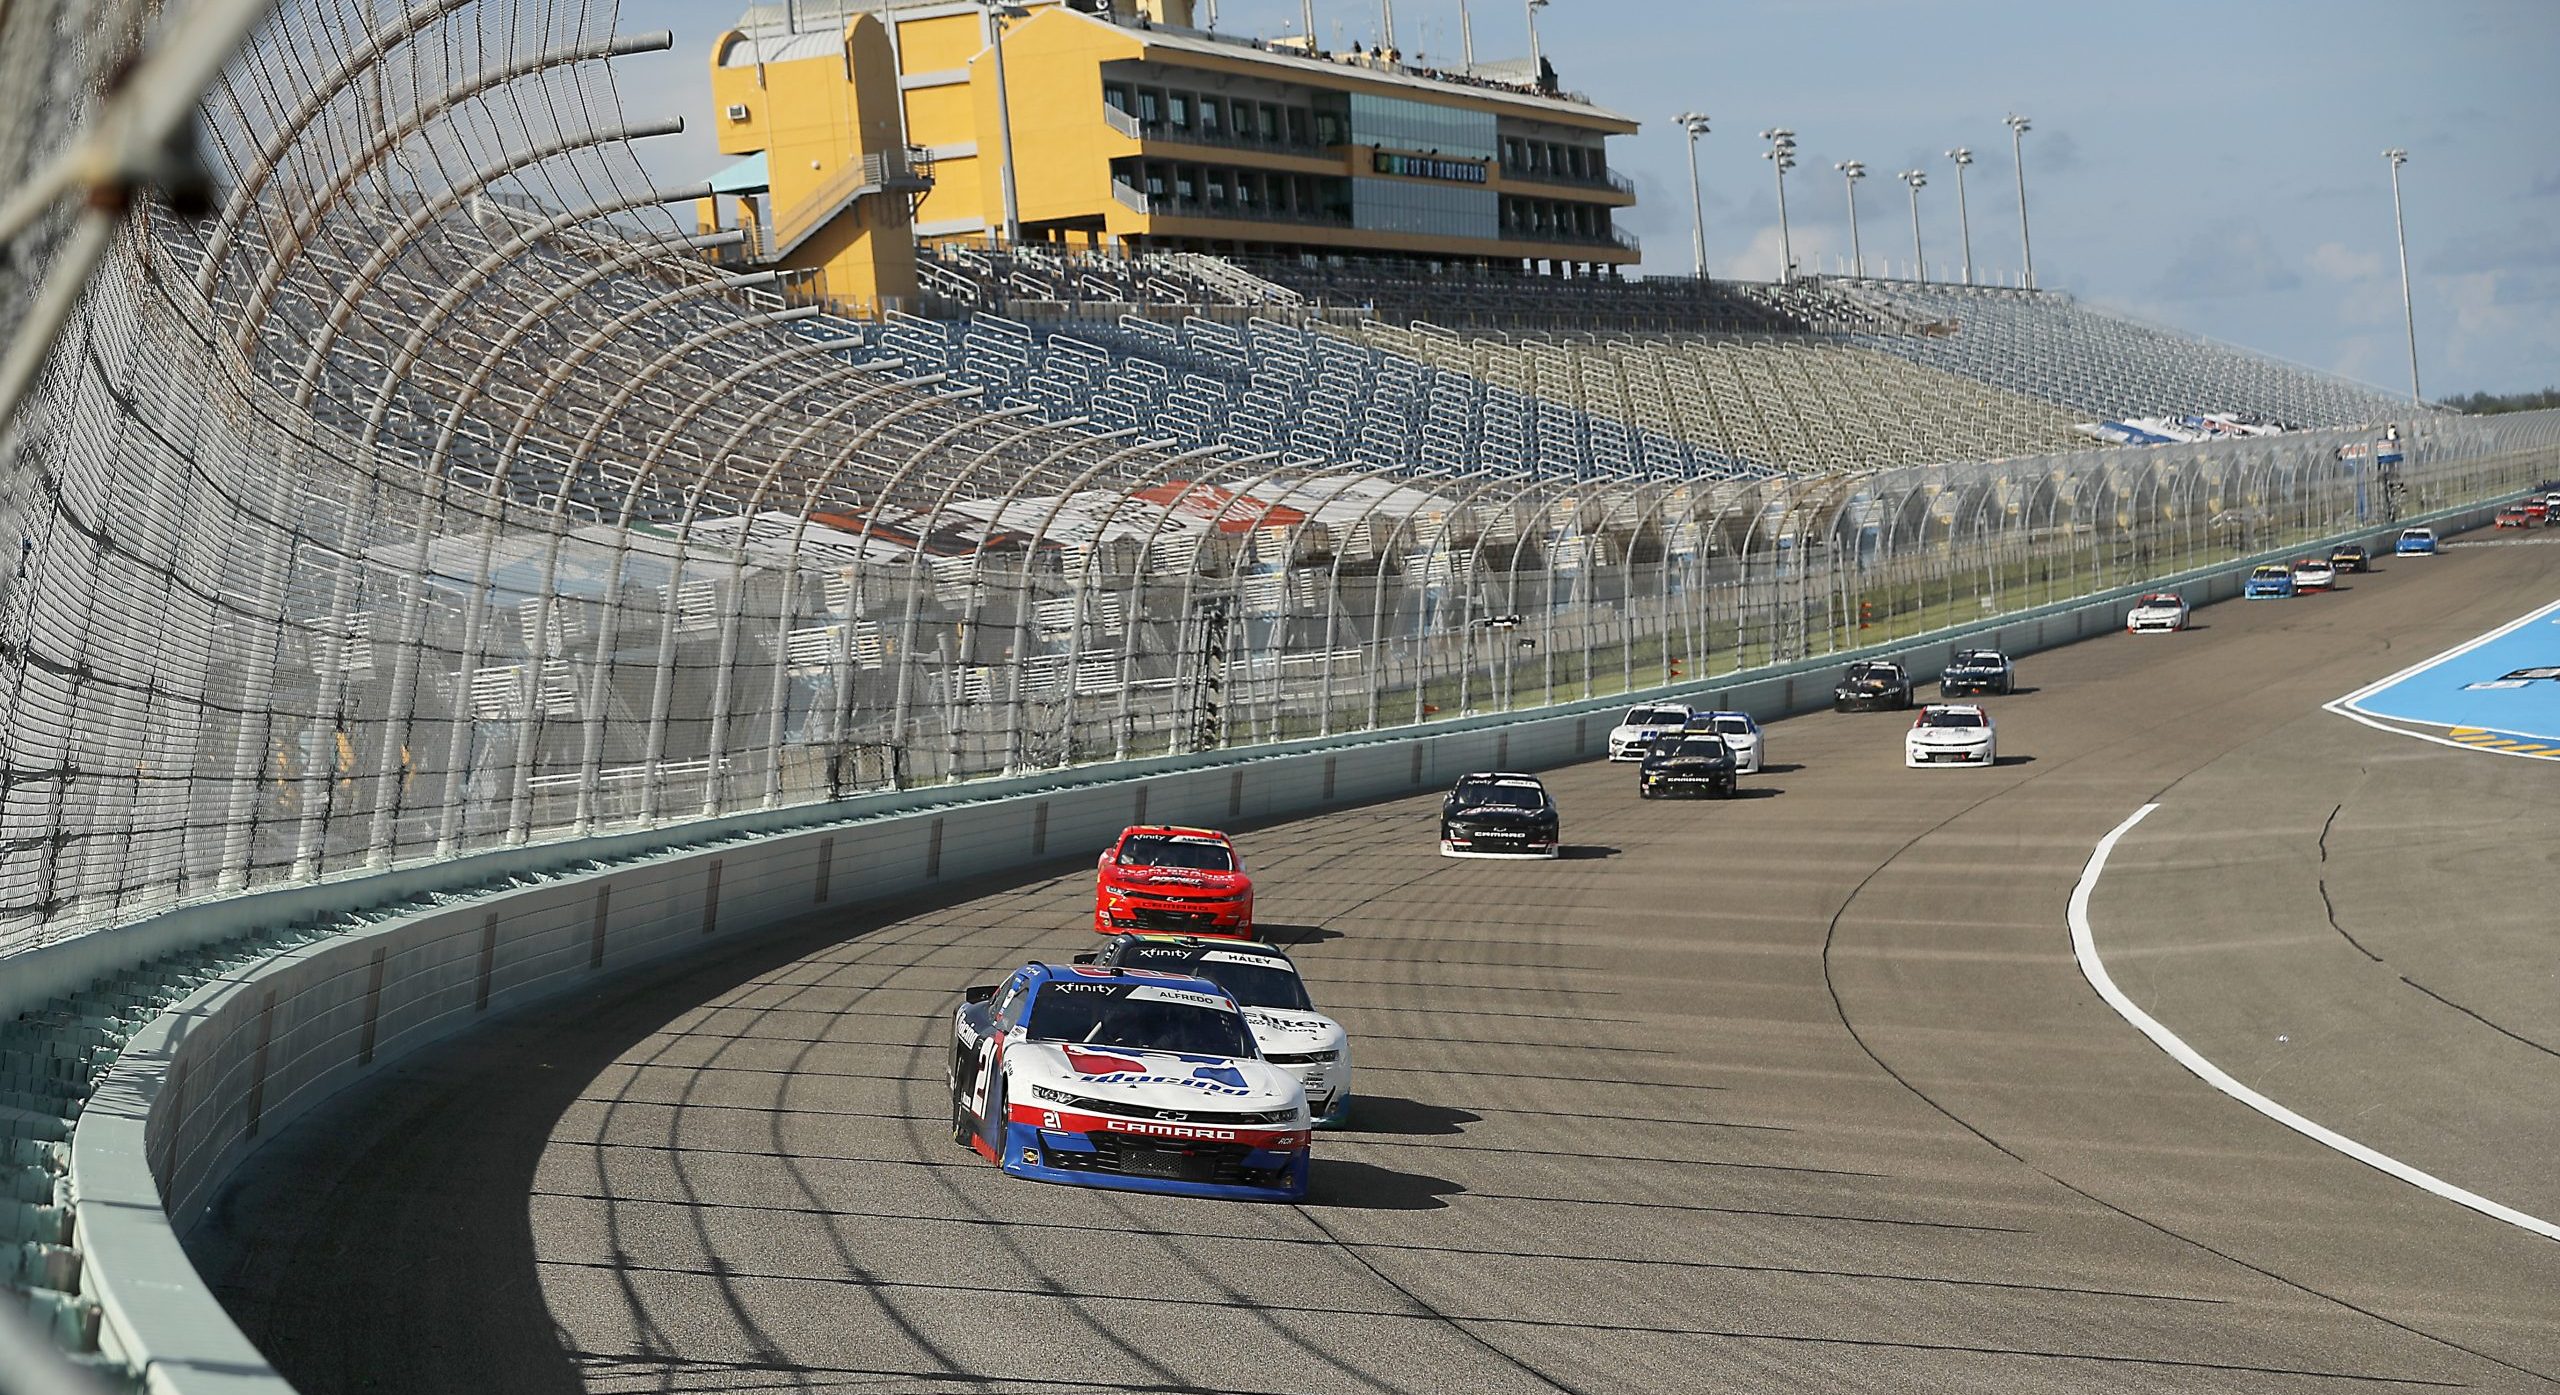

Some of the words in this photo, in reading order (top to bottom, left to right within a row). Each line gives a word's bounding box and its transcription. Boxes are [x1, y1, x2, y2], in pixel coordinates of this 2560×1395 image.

[1133, 834, 1166, 842] xfinity
[1141, 901, 1209, 912] CAMARO
[1139, 947, 1193, 960] xfinity
[1228, 953, 1272, 966] HALEY
[1054, 981, 1118, 996] xfinity
[1159, 991, 1214, 1005] ALFREDO
[970, 1036, 998, 1121] 21
[1042, 1110, 1062, 1130] 21
[1106, 1120, 1236, 1140] CAMARO
